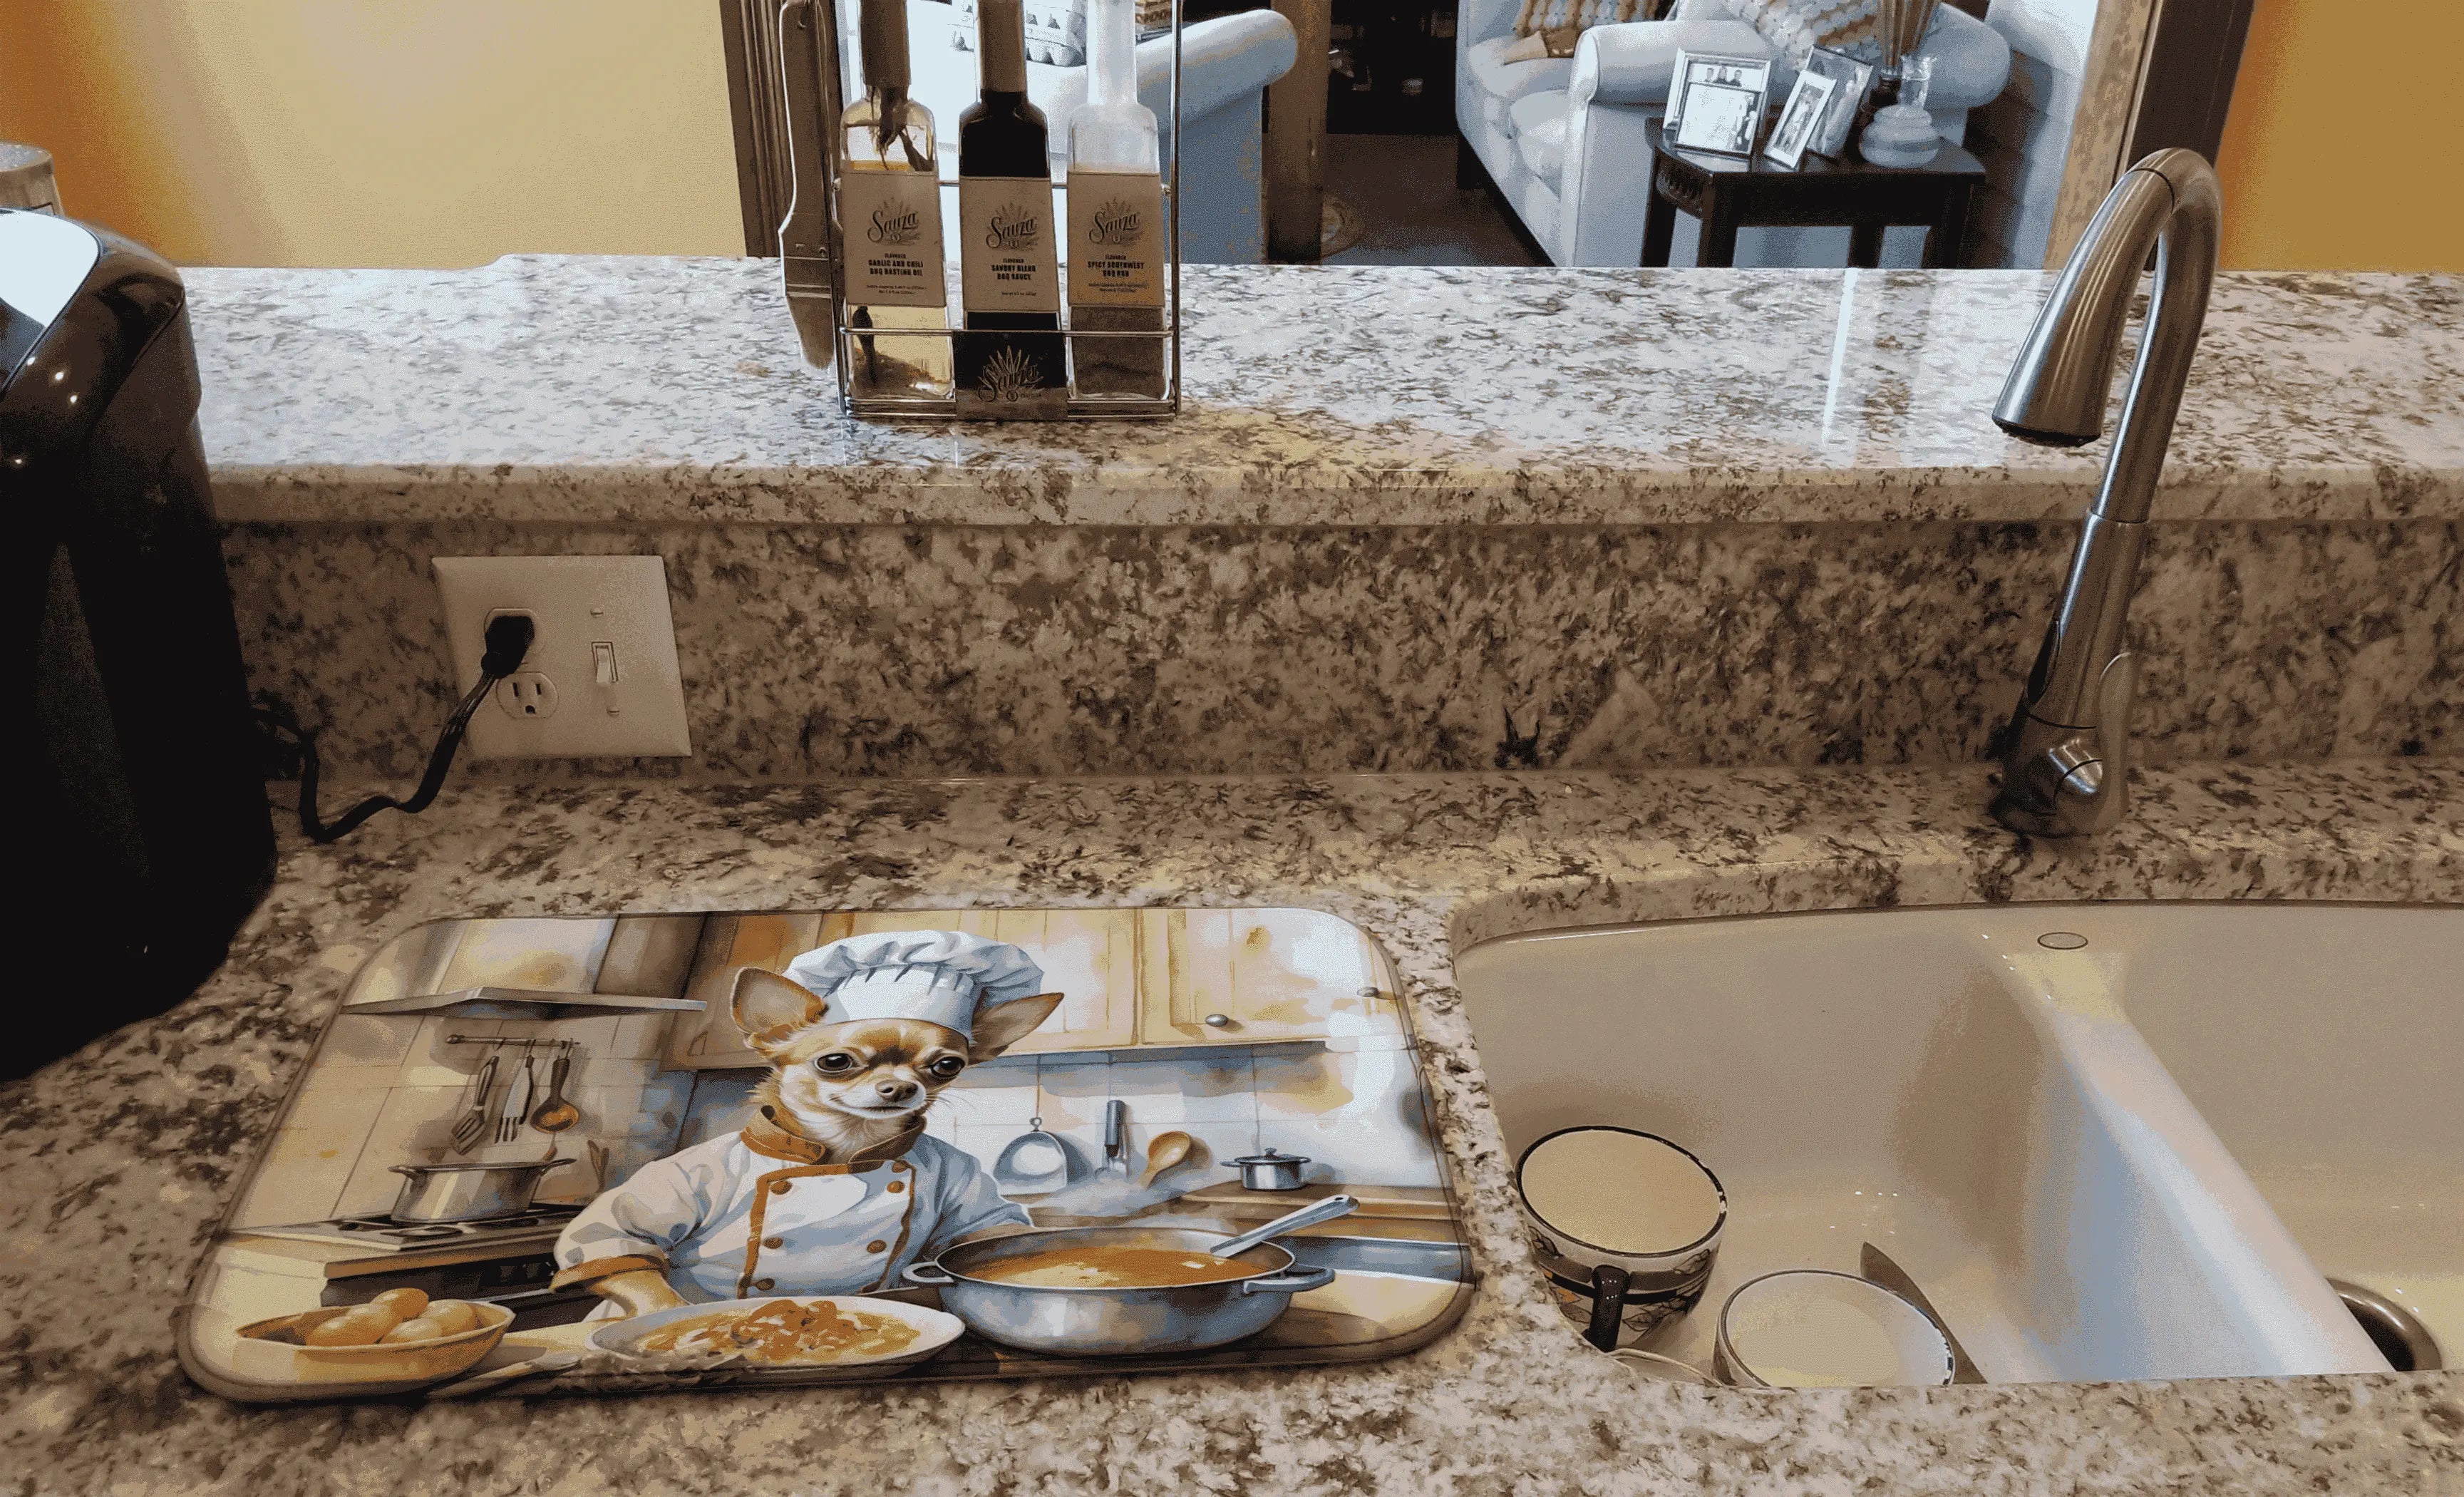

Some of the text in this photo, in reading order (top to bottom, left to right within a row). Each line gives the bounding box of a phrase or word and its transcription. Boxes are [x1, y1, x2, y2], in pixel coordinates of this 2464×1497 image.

[867, 210, 919, 243] Sauza
[986, 216, 1038, 249] Sauza
[1089, 211, 1141, 243] Sauza
